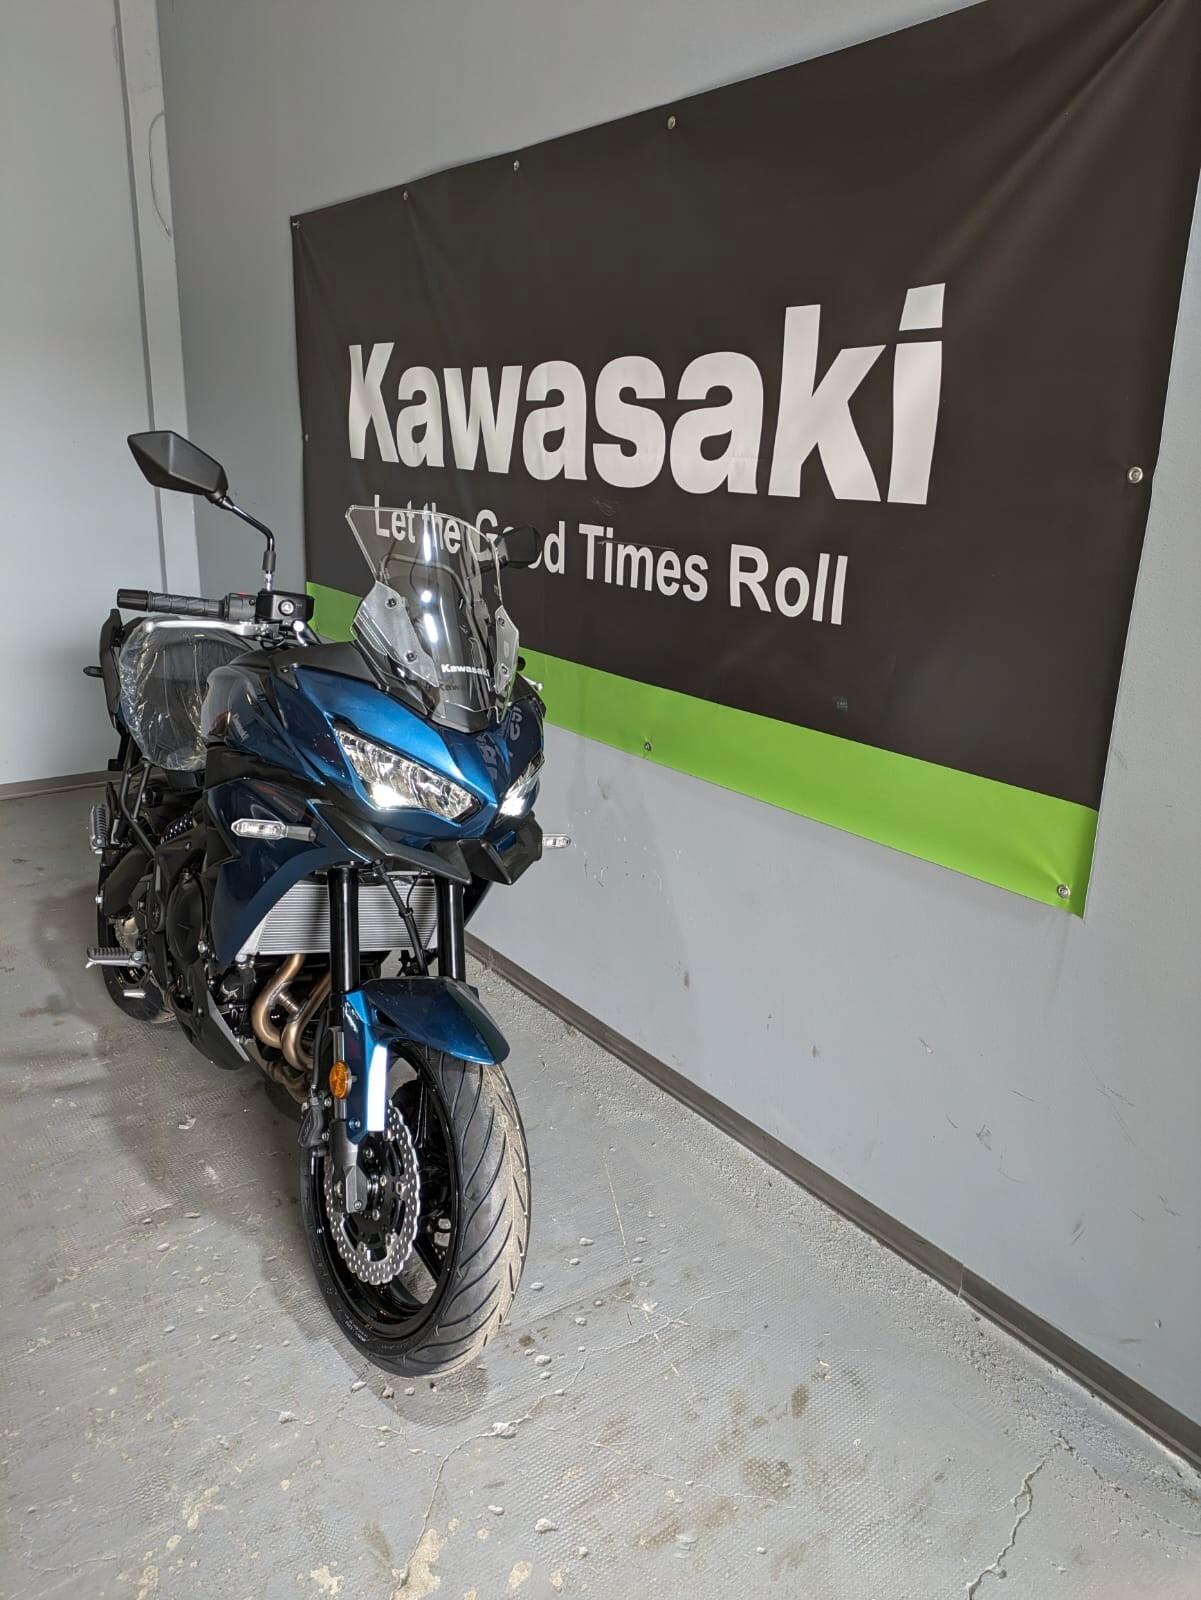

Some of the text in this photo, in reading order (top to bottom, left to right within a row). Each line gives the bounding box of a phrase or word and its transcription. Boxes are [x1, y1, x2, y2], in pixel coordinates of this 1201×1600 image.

[349, 283, 946, 505] Kawasaki
[374, 494, 848, 626] Let the Gd Times Roll
[441, 664, 490, 677] Kawasaki
